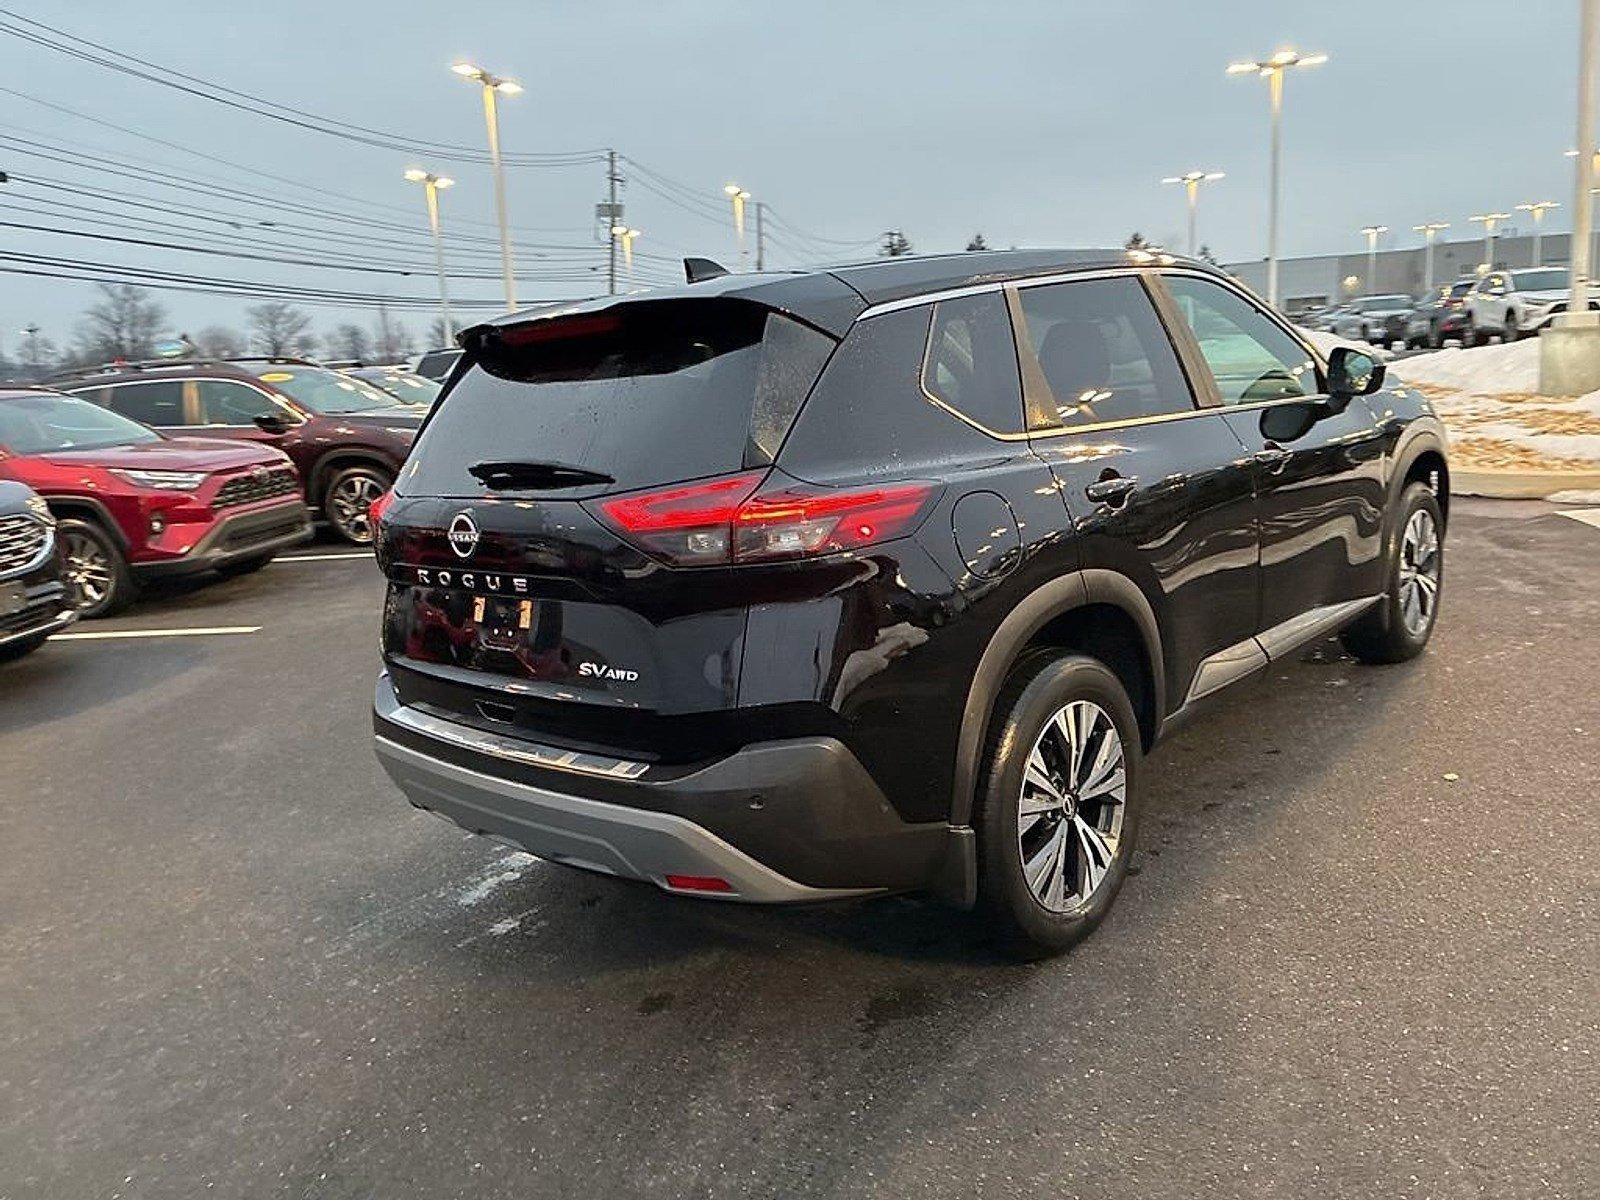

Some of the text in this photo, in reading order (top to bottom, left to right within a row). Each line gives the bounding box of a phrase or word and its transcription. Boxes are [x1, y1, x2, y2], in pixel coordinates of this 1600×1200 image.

[448, 532, 479, 542] NISSAN
[417, 568, 528, 592] ROGUE
[578, 662, 638, 681] SV AWD
